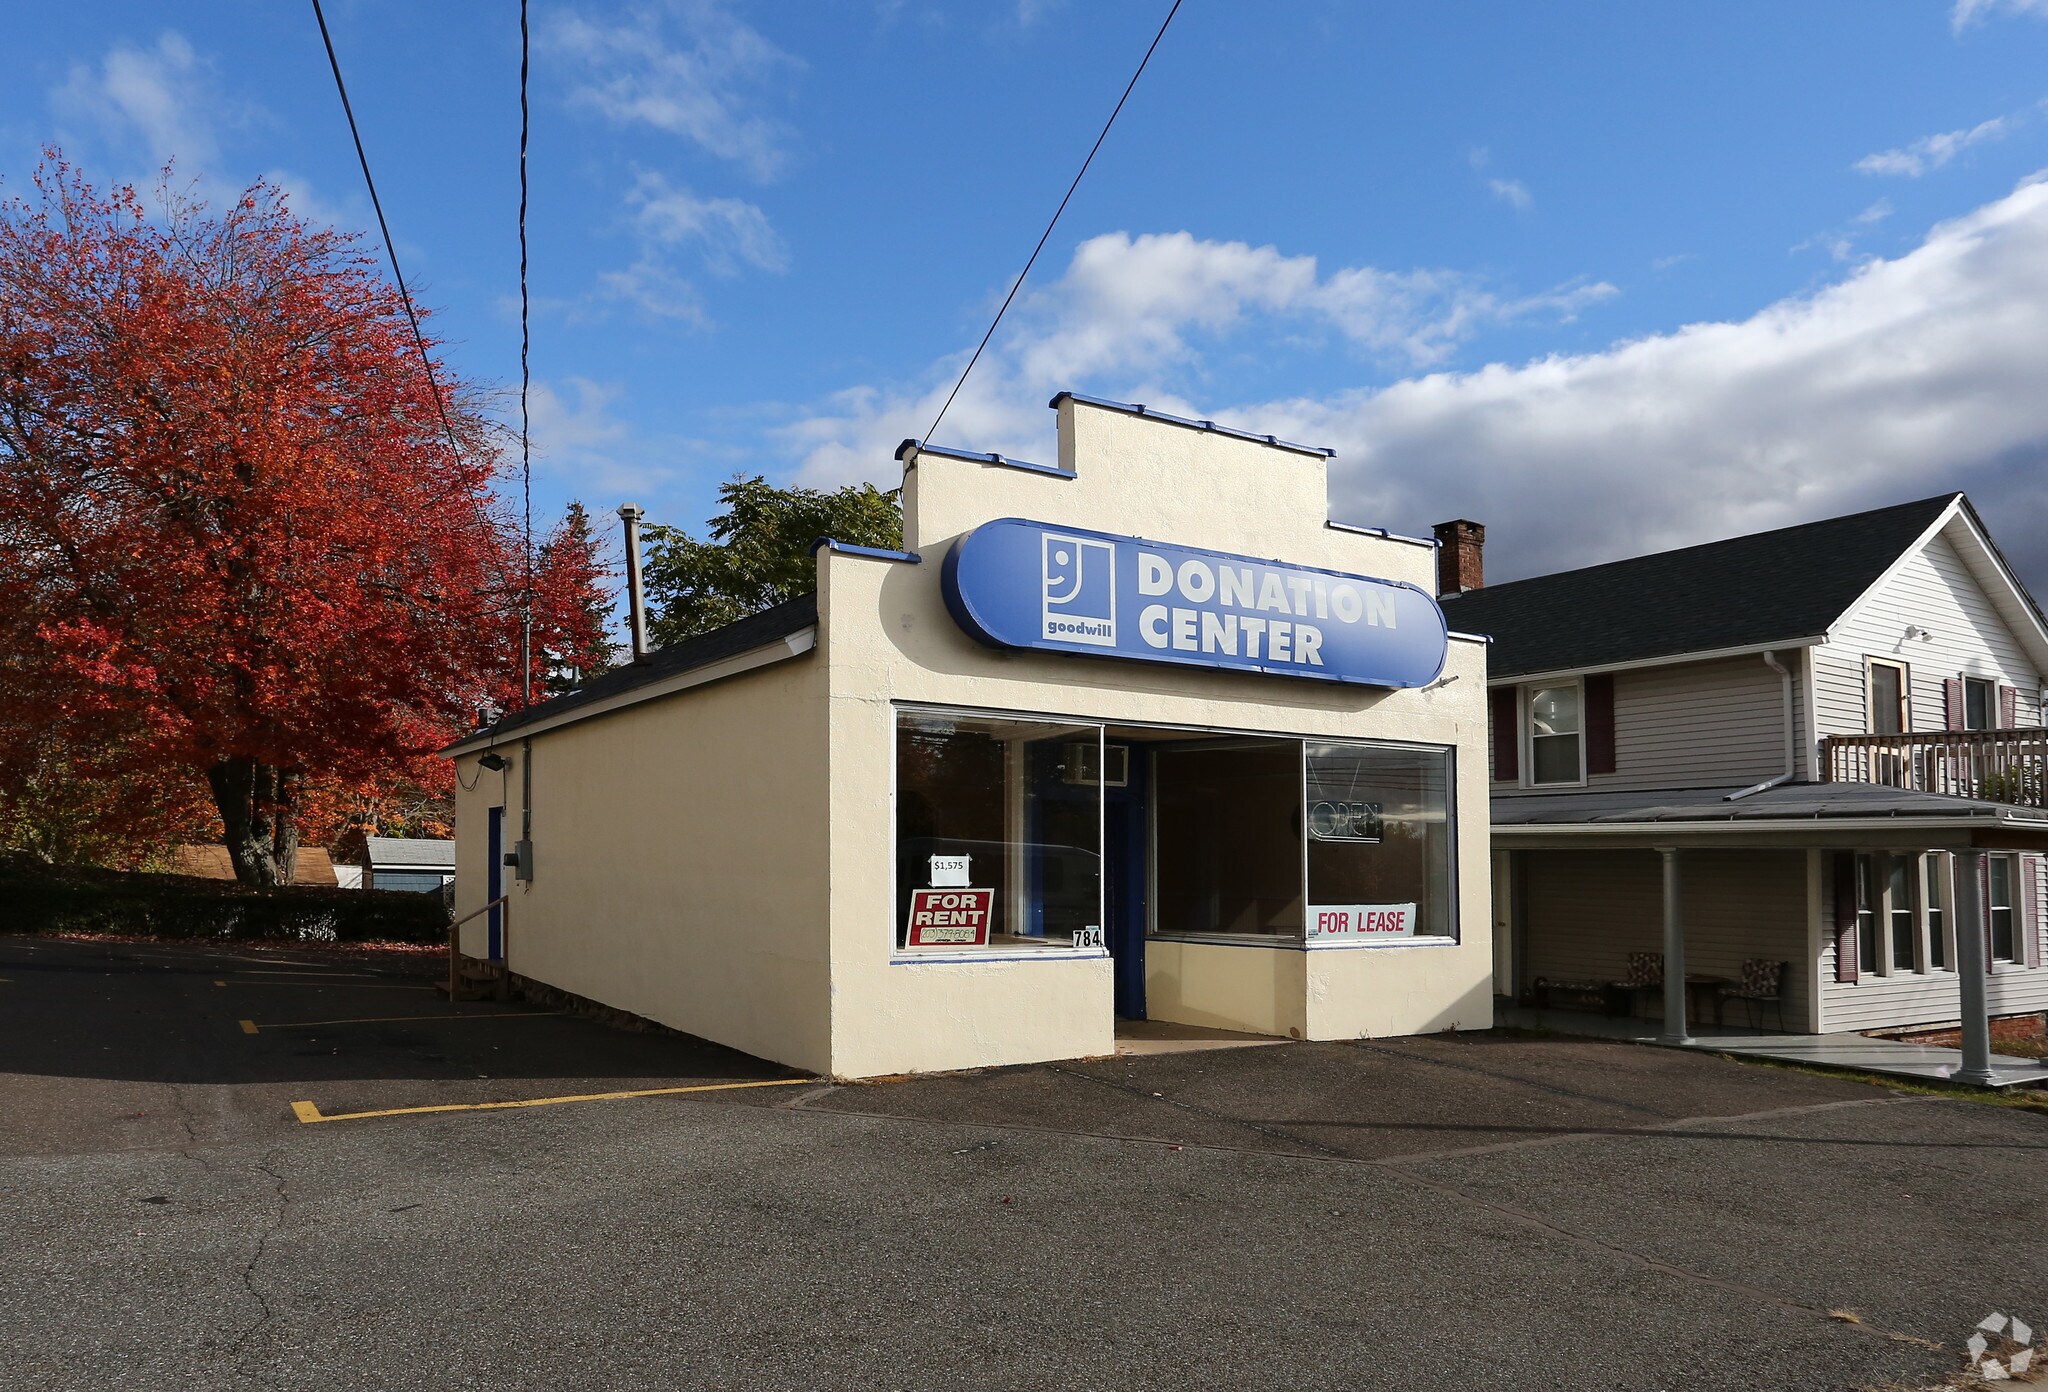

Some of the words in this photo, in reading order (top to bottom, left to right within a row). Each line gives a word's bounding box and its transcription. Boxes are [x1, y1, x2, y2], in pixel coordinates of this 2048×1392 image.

[1137, 552, 1397, 629] DONATION
[1048, 621, 1112, 638] goodwill
[1137, 605, 1324, 667] CENTER
[1312, 801, 1378, 836] OPEN
[934, 861, 964, 871] $1,575
[926, 894, 977, 909] FOR
[915, 910, 985, 926] RENT
[1317, 912, 1349, 933] FOR
[1357, 911, 1405, 933] LEASE
[1075, 930, 1100, 947] 784
